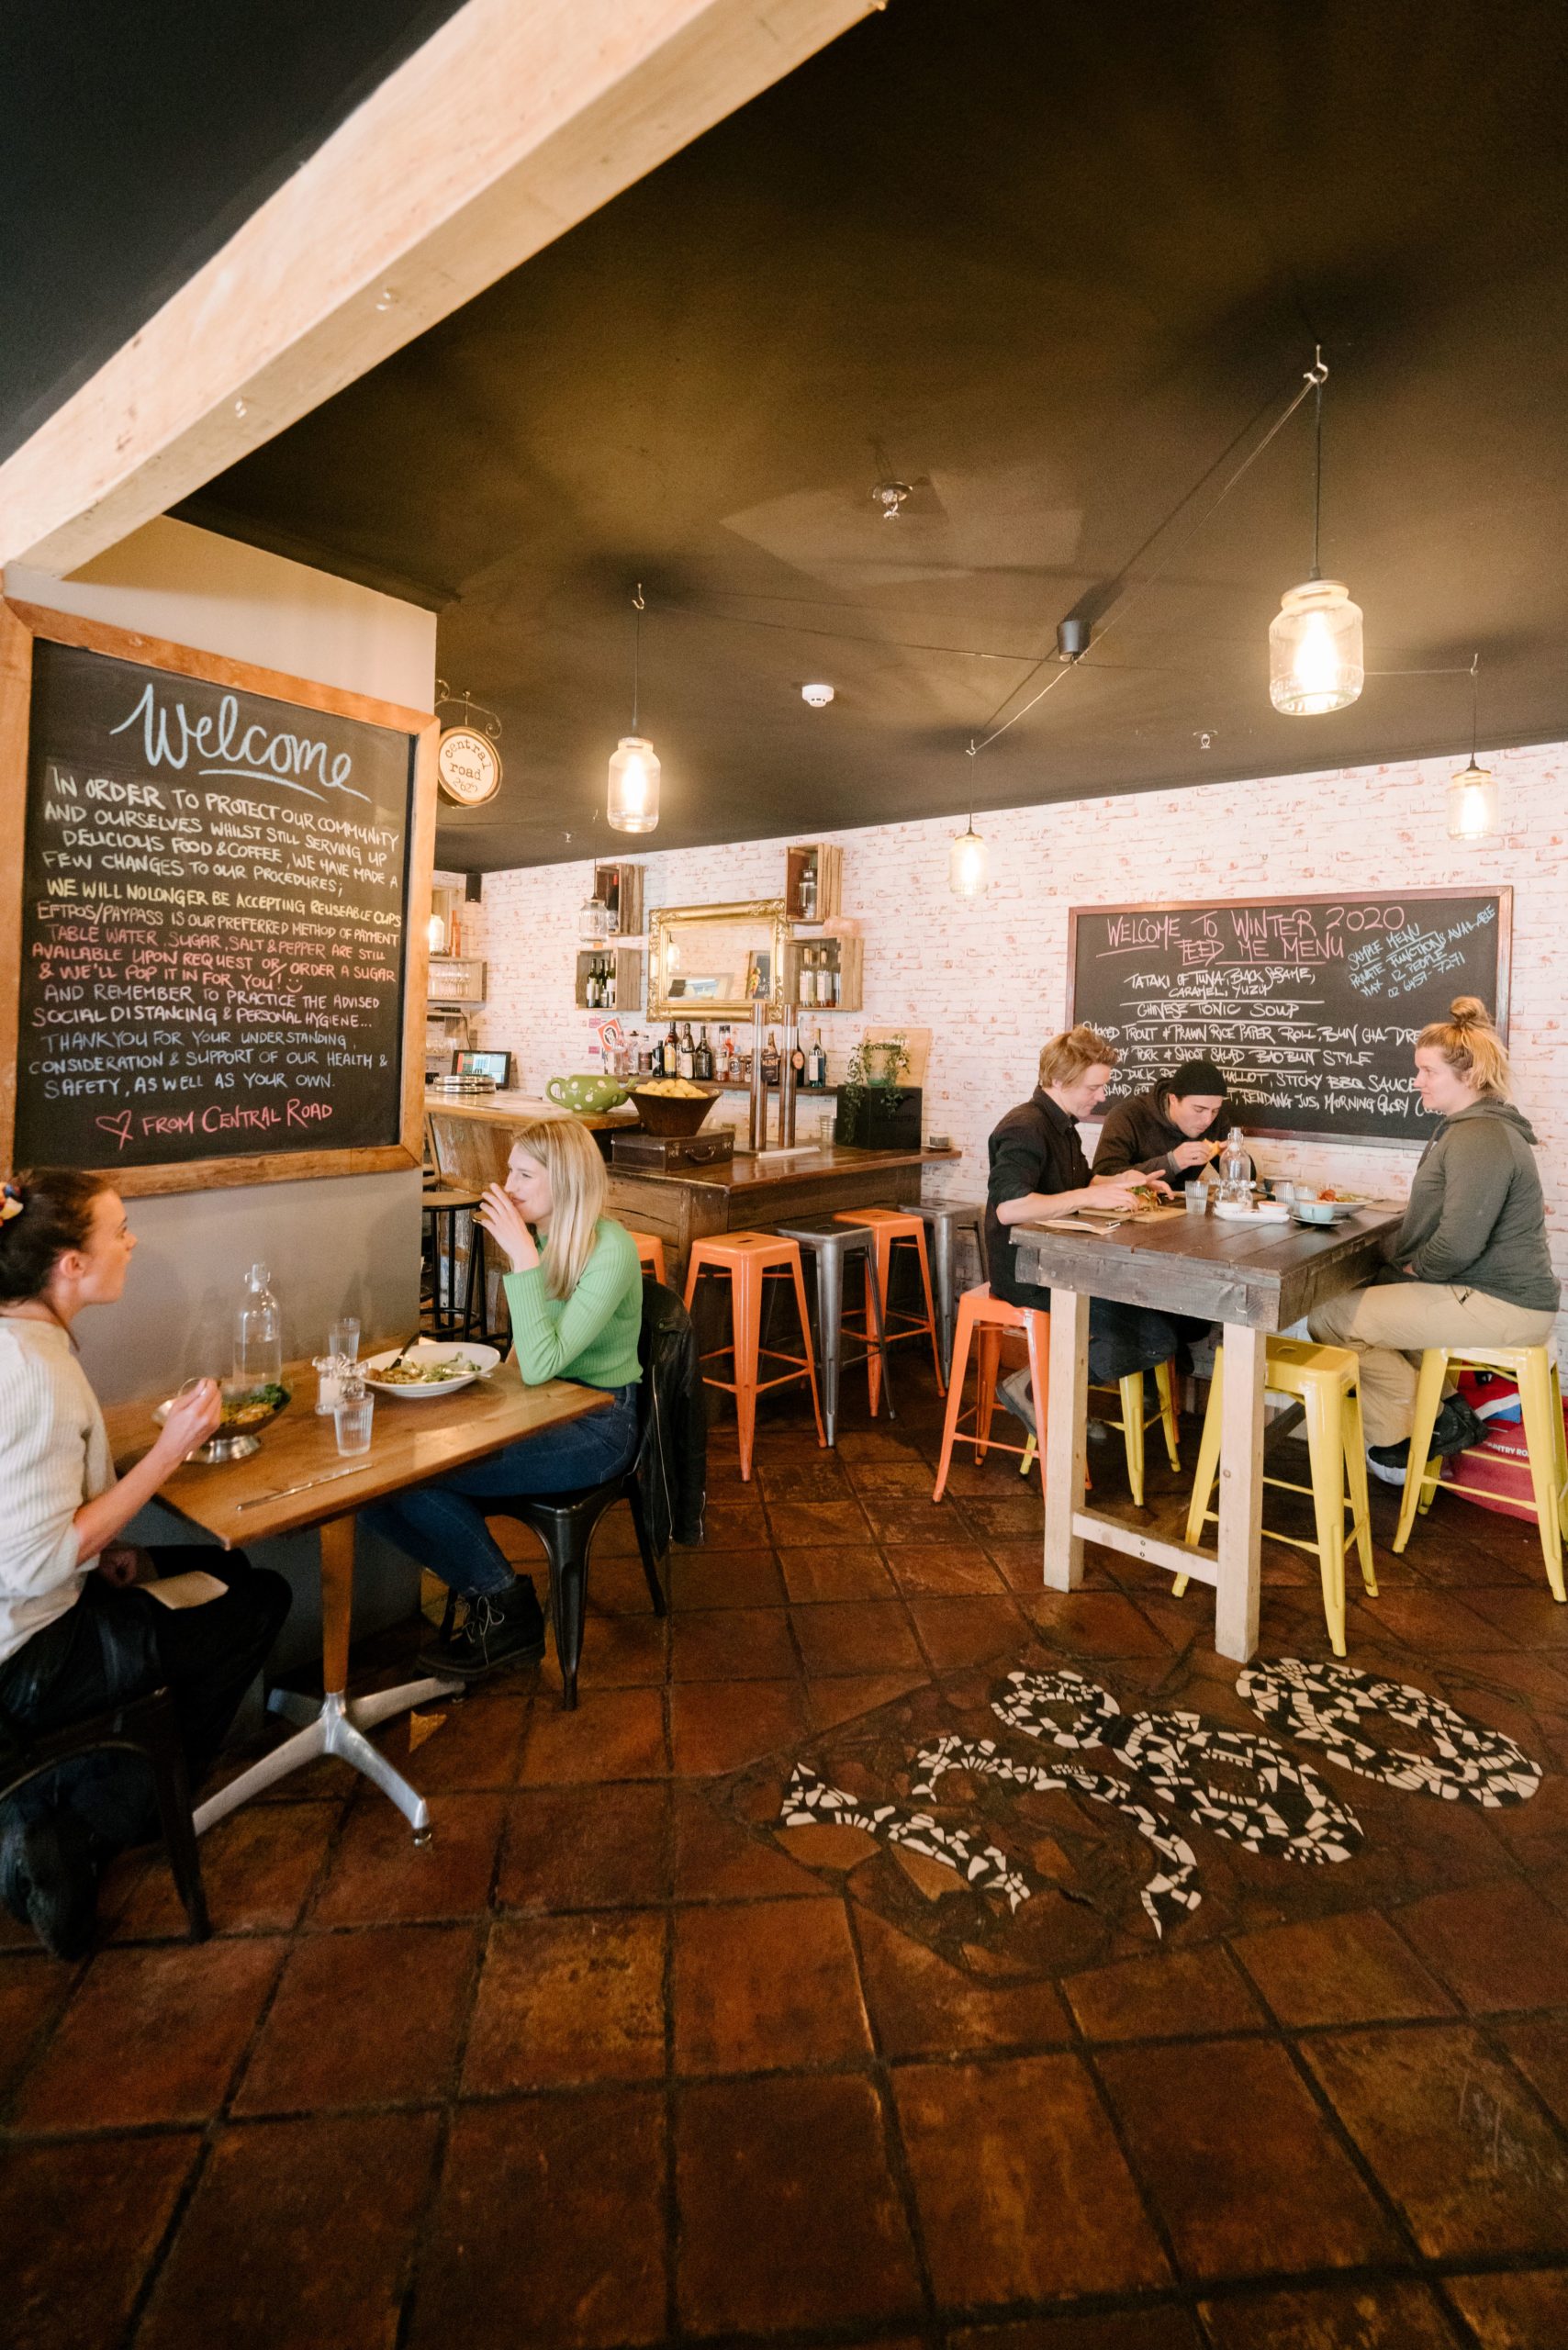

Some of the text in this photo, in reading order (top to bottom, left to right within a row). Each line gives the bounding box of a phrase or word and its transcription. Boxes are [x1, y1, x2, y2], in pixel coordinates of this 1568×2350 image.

[110, 683, 372, 803] Welcome
[445, 738, 492, 770] central
[450, 763, 482, 781] road
[51, 767, 399, 852] IN ORDER TO PROTECT OUR COMMUNITY
[45, 800, 387, 867] AND OURSELVES WHILST STILL SERVING UP
[42, 851, 93, 871] FEW
[101, 853, 185, 877] CHANGES
[188, 861, 209, 876] TO
[213, 865, 248, 879] OUR
[62, 829, 164, 852] DELICIOUS
[171, 837, 213, 856] FOOD
[319, 859, 350, 877] HAVE
[353, 867, 385, 884] MADE
[390, 876, 398, 890] A
[47, 877, 79, 897] WE
[83, 880, 123, 900] WILL
[212, 890, 230, 907] BE
[236, 891, 306, 915] ACCEPTING
[310, 900, 373, 923] REUSEABLE
[171, 912, 185, 926] IS
[187, 914, 216, 929] OUR
[218, 916, 289, 934] PREFERRED
[292, 922, 336, 939] METHOD
[340, 927, 353, 940] OF
[353, 929, 399, 947] PAYMENT
[1106, 905, 1405, 950] WELCOME TO WINTER 2020
[46, 923, 99, 943] TABLE
[230, 935, 264, 952] SALT
[331, 944, 353, 958] ARE
[358, 948, 386, 961] STILL
[1173, 932, 1344, 967] FEED ME MENU
[1348, 923, 1420, 970] SAMPLE MENU
[32, 942, 124, 961] AVAILABLE
[132, 949, 178, 965] UPON
[183, 952, 253, 969] REQUEST
[290, 962, 337, 979] ORDER
[341, 965, 350, 978] A
[353, 965, 397, 982] SUGAR
[1348, 962, 1386, 989] PRIVATE
[39, 962, 54, 980] &
[60, 963, 118, 979] WE'LL
[125, 964, 158, 982] POP
[164, 968, 177, 981] IT
[182, 969, 198, 982] IN
[202, 971, 234, 990] FOR
[1124, 973, 1170, 989] TATAKI
[1177, 973, 1190, 987] OF
[1361, 979, 1383, 998] MAX
[44, 983, 380, 1010] AND REMEMBER TO PRACTICE THE ADVISED
[1387, 987, 1400, 998] 02
[31, 1007, 107, 1027] SOCIAL
[110, 1005, 218, 1026] DISTANCING
[223, 1006, 232, 1021] &
[236, 1008, 303, 1024] PERSONAL
[1137, 1002, 1300, 1020] CHINESE TONIC SOUP
[153, 1030, 185, 1046] FOR
[192, 1029, 231, 1047] YOUR
[1121, 1023, 1159, 1041] TROUT
[1208, 1024, 1236, 1041] RICE
[1233, 1023, 1277, 1045] PAPER
[28, 1049, 389, 1075] CONSIDERATION & SUPPORT OF OUR HEALTH &
[1210, 1046, 1245, 1066] SALAD
[1322, 1049, 1375, 1067] STYLE
[135, 1076, 158, 1094] AS
[162, 1075, 204, 1091] WELL
[215, 1072, 235, 1089] AS
[243, 1072, 288, 1089] YOUR
[1103, 1083, 1132, 1099] SLAND
[1122, 1068, 1157, 1082] DUCK
[1222, 1069, 1273, 1088] HALLOT,
[142, 1098, 333, 1136] FROM CENTRAL ROAD
